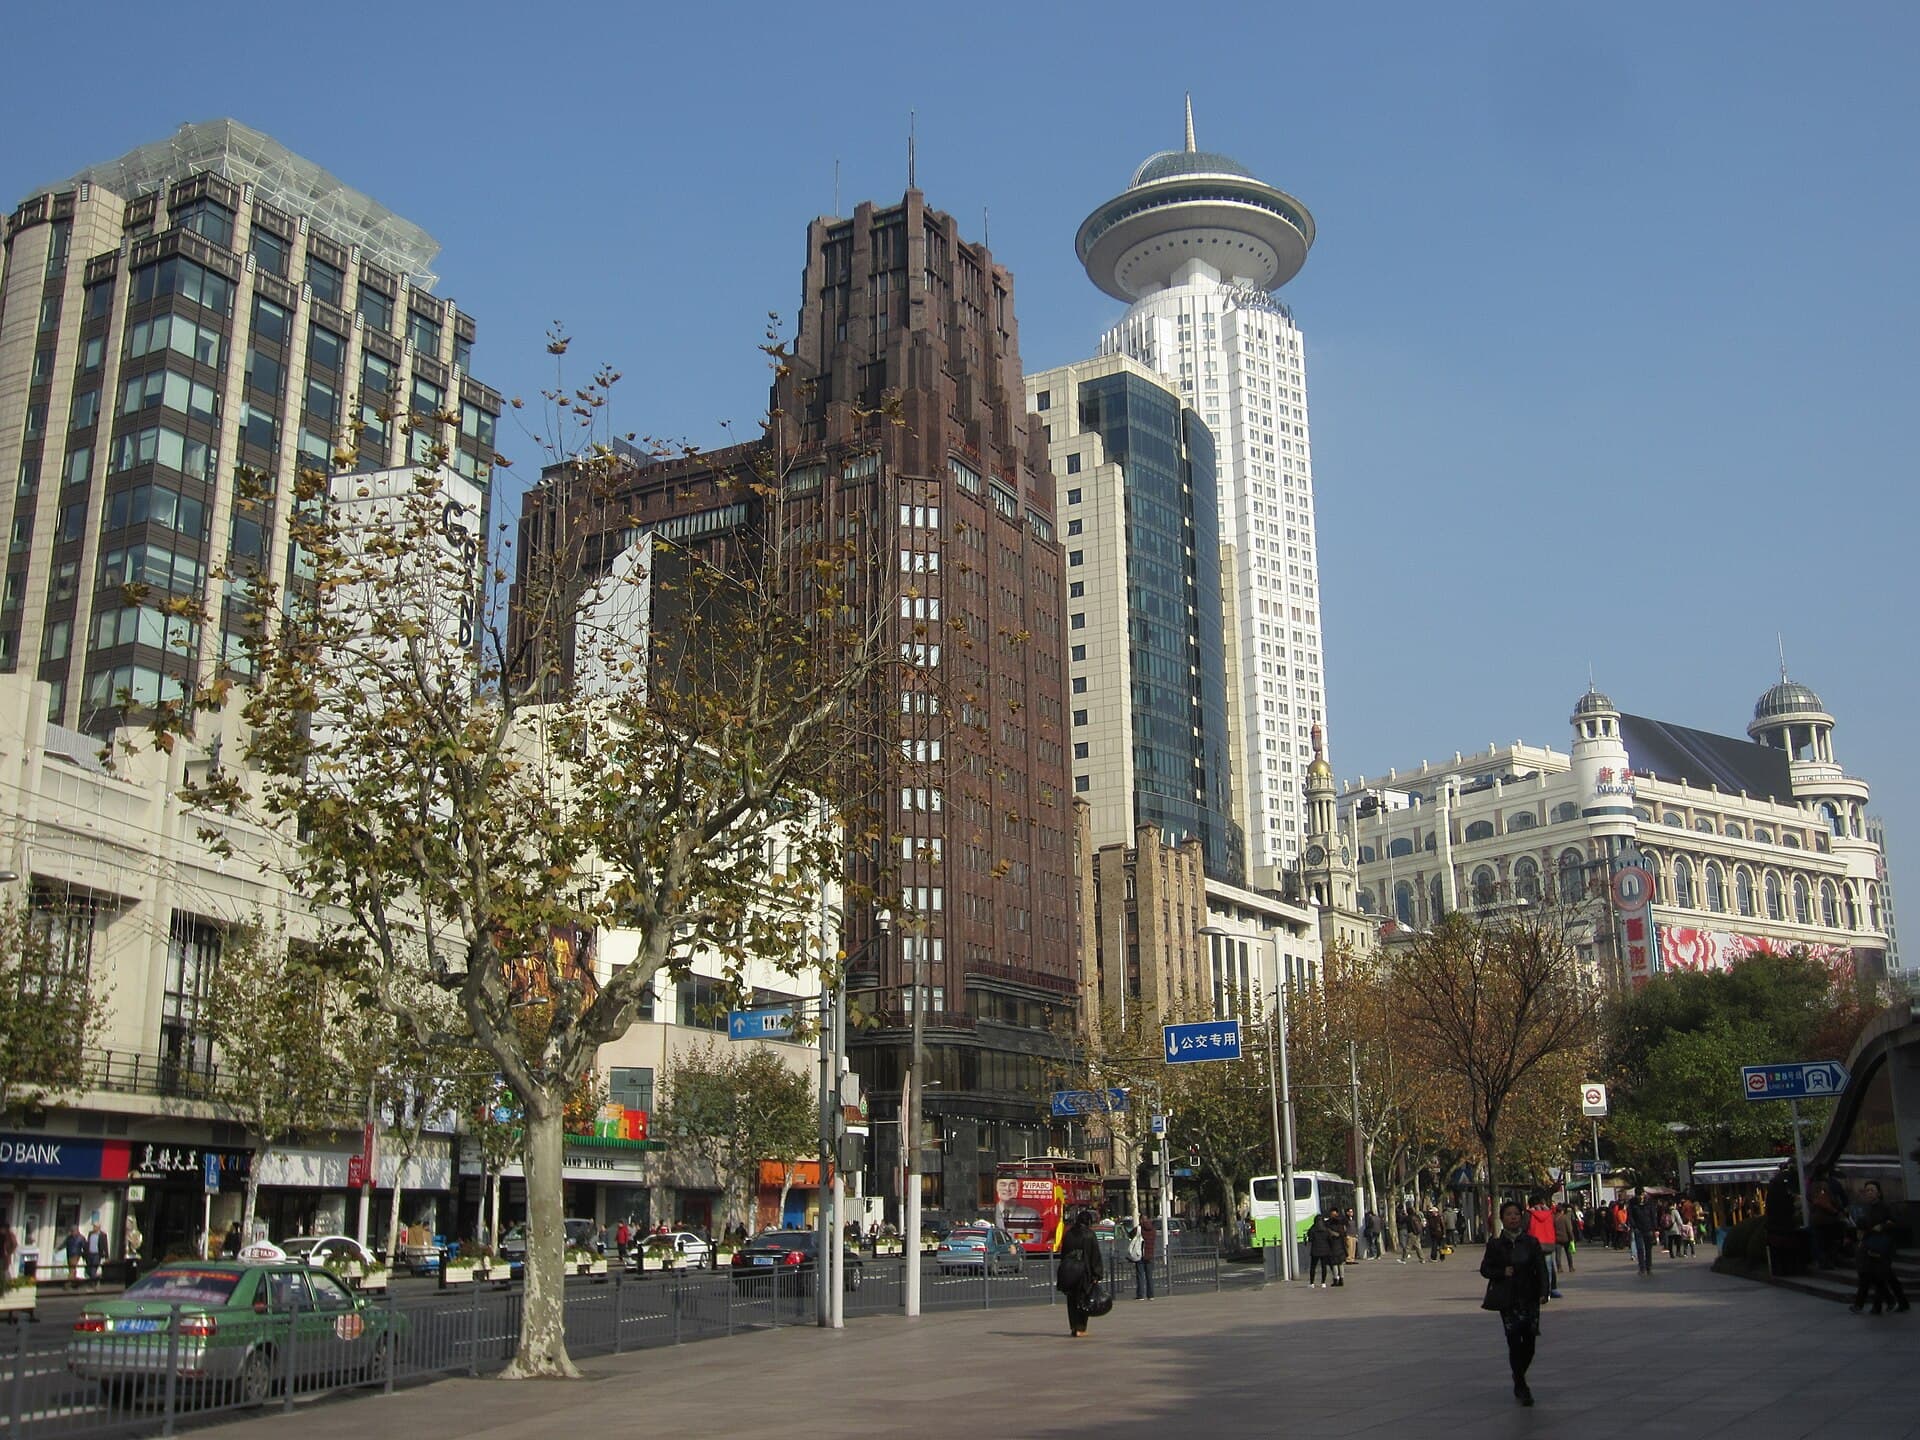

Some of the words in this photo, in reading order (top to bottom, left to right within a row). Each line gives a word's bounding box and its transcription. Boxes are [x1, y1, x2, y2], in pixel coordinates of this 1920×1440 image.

[1181, 1032, 1236, 1049] 公交专用
[15, 1144, 61, 1165] BANK
